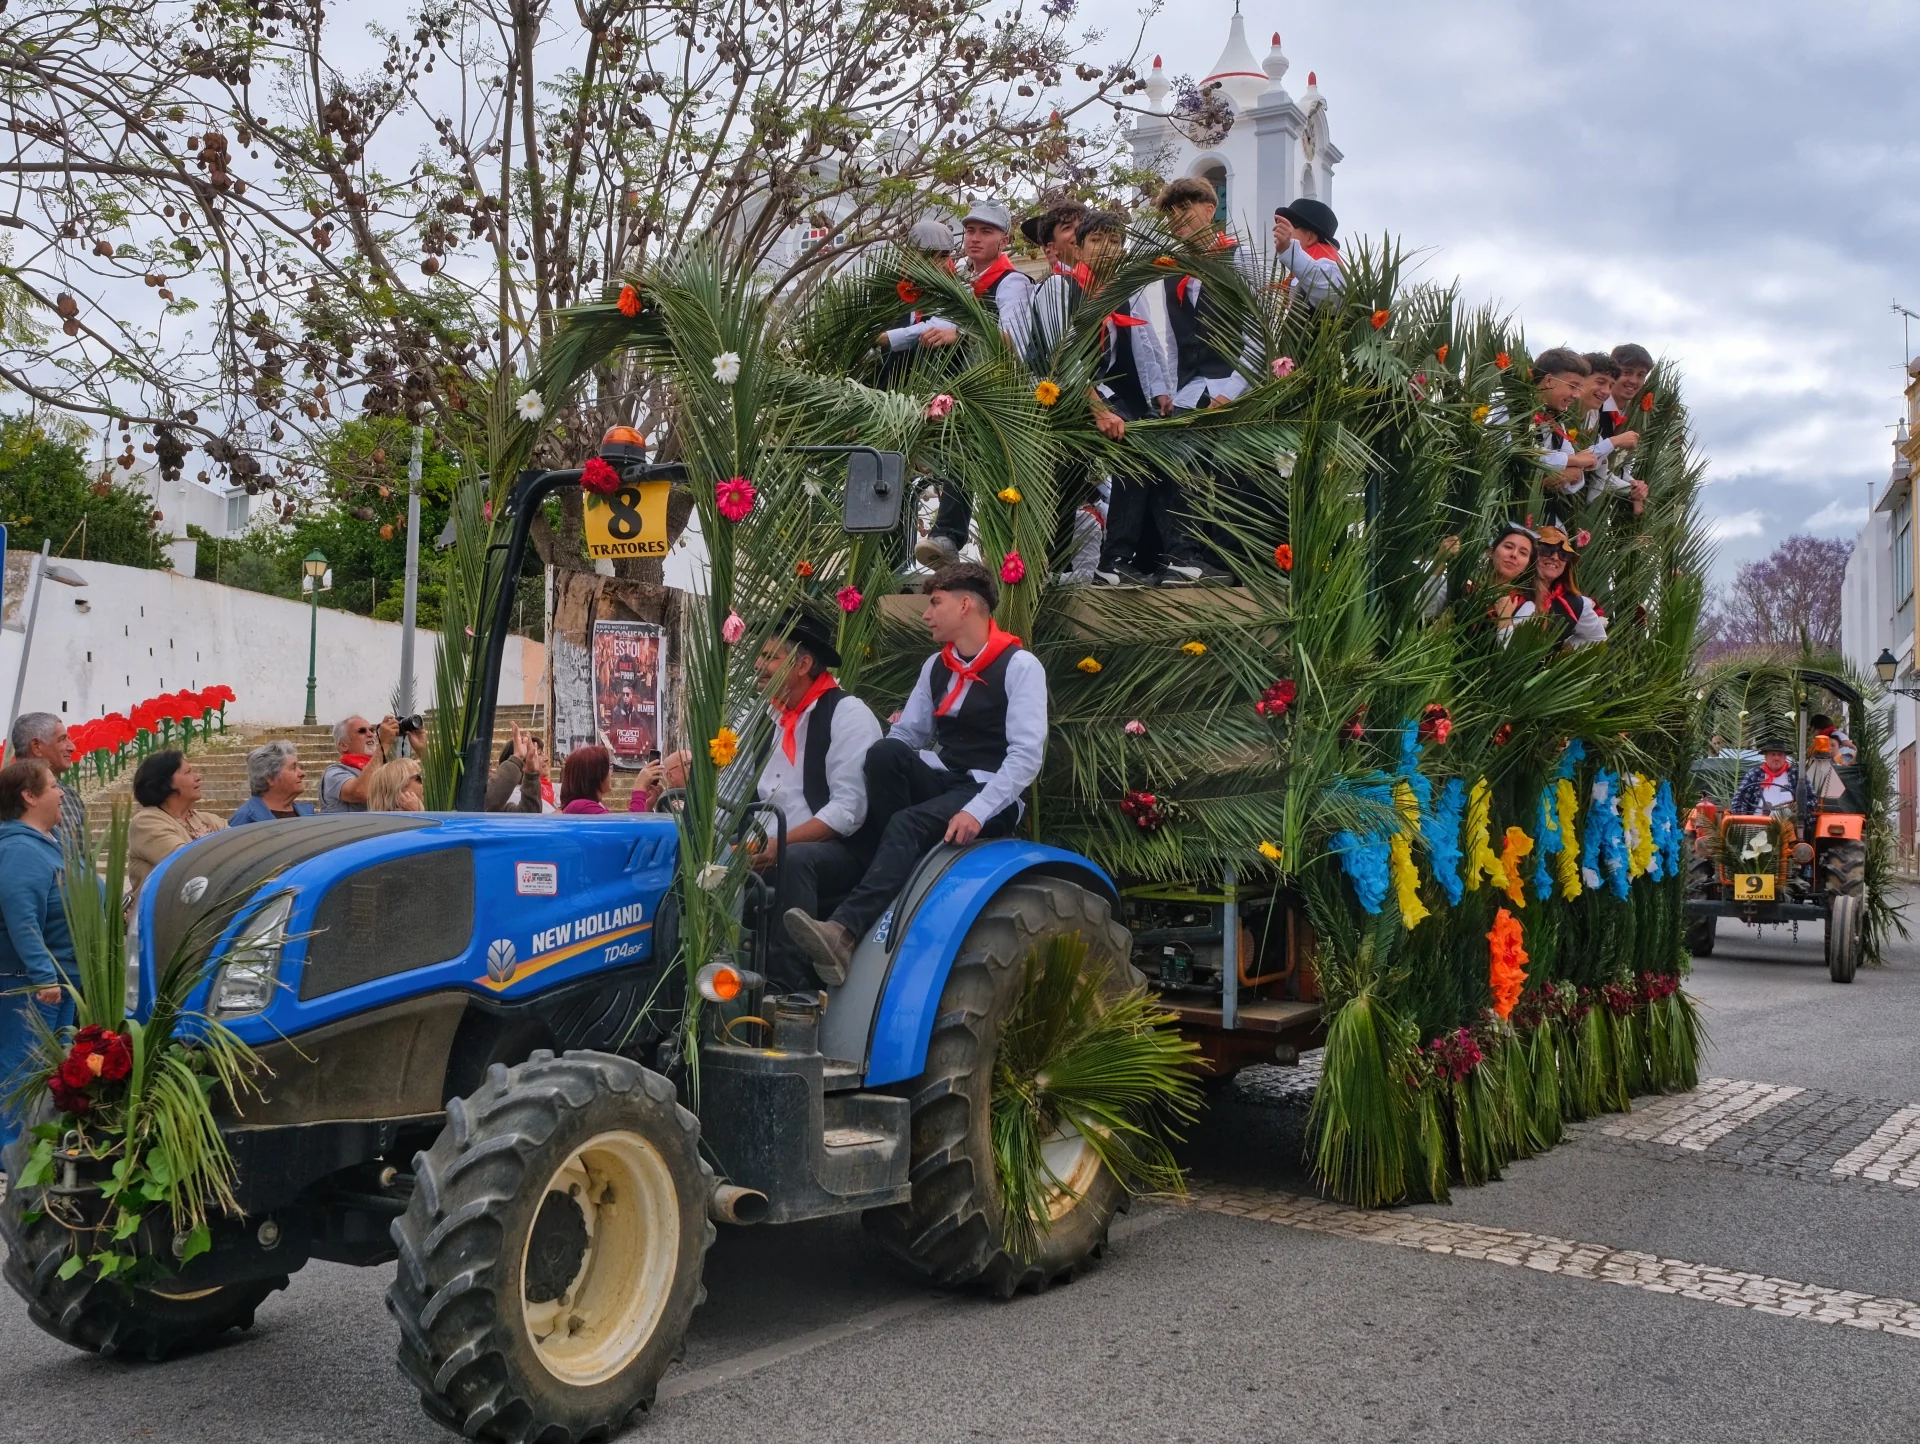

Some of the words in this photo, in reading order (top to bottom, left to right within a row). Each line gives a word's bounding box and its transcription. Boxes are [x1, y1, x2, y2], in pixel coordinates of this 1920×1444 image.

[608, 488, 642, 540] 8
[591, 541, 665, 555] TRATORES
[614, 640, 640, 657] ESTOI
[1746, 876, 1763, 893] 9
[533, 923, 571, 954] NEW
[575, 903, 643, 940] HOLLAND
